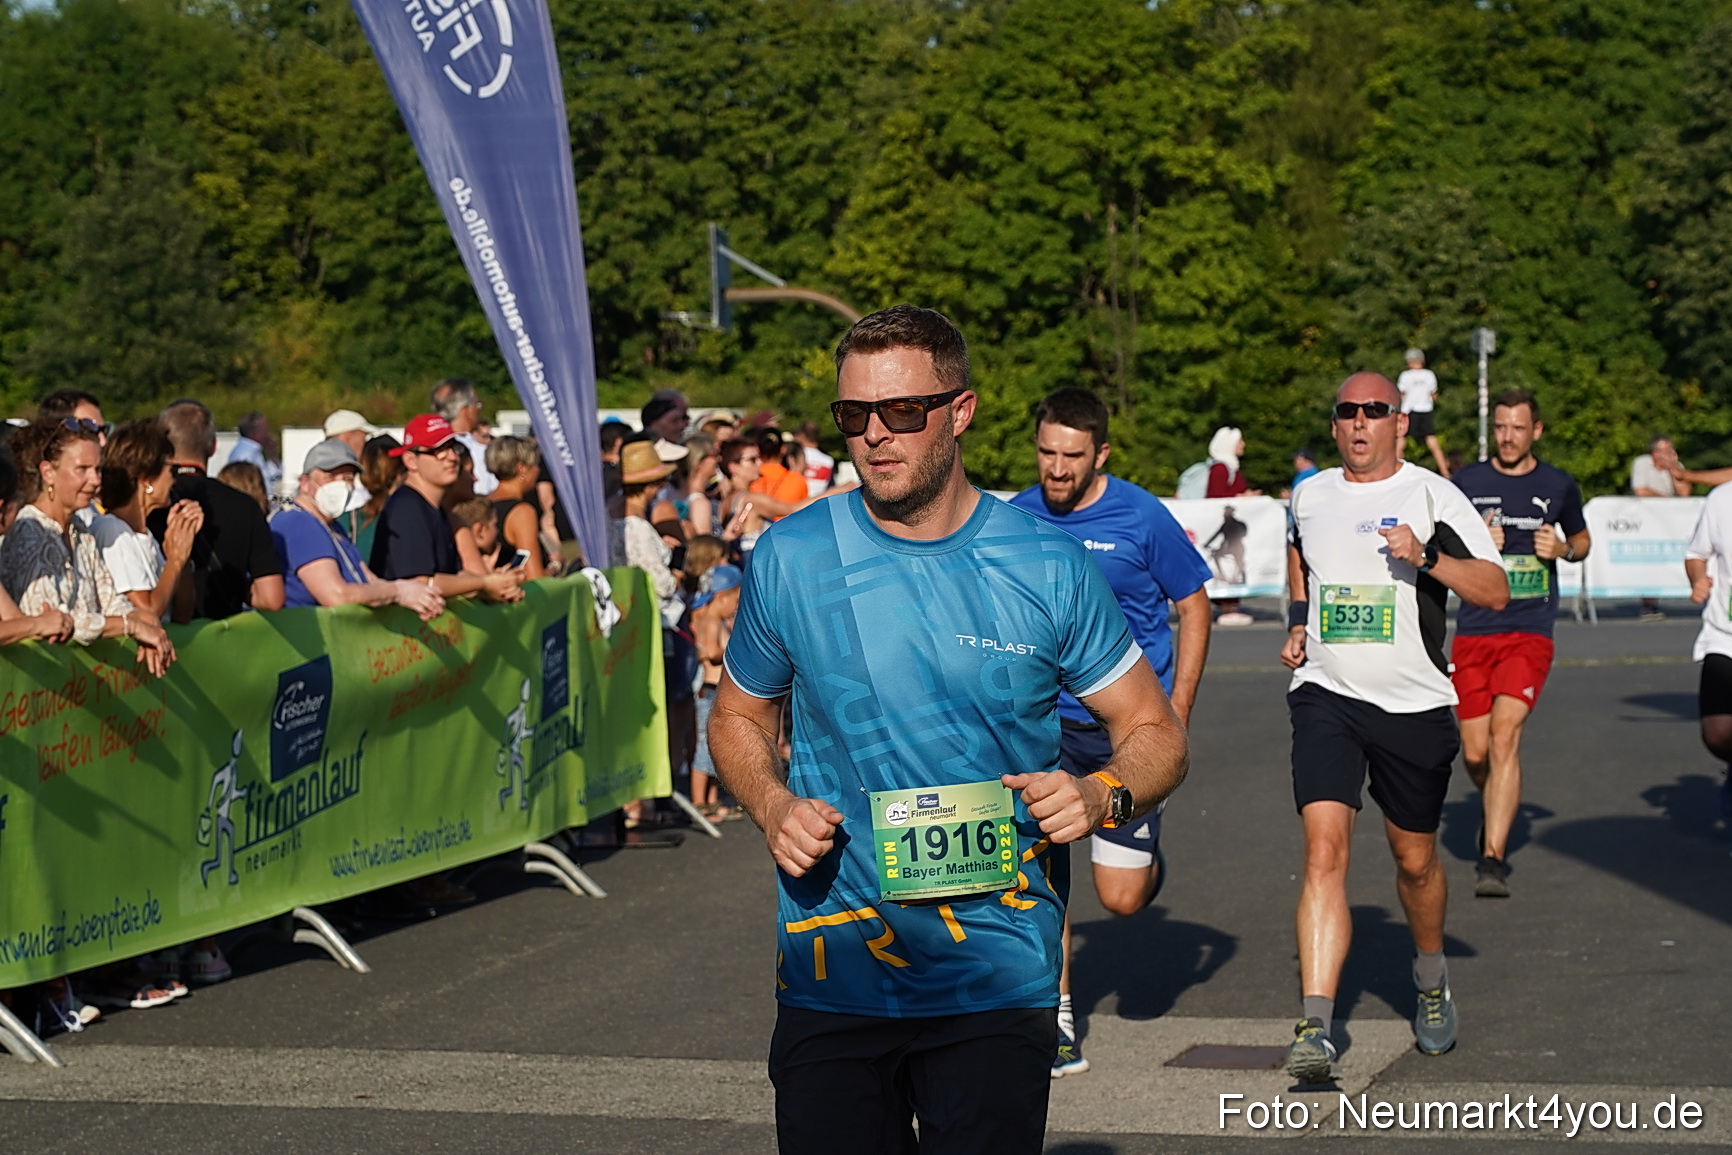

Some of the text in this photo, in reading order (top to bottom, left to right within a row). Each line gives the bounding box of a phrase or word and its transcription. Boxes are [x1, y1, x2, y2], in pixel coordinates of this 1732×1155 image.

[1093, 540, 1116, 552] Berger
[1335, 604, 1374, 624] 533
[1382, 607, 1392, 637] 2022
[955, 634, 1038, 656] TR PLAST
[982, 653, 1017, 662] GROUP
[0, 664, 88, 736] Gesunde
[281, 694, 325, 723] Fischer
[37, 688, 167, 784] laufen länger!
[245, 729, 368, 846] firmenlauf
[911, 804, 957, 818] Firmenlauf
[929, 812, 957, 821] neumarkt
[901, 820, 997, 862] 1916
[999, 823, 1013, 873] 2022
[883, 841, 899, 879] RUN
[902, 860, 999, 880] Bayer Matthias
